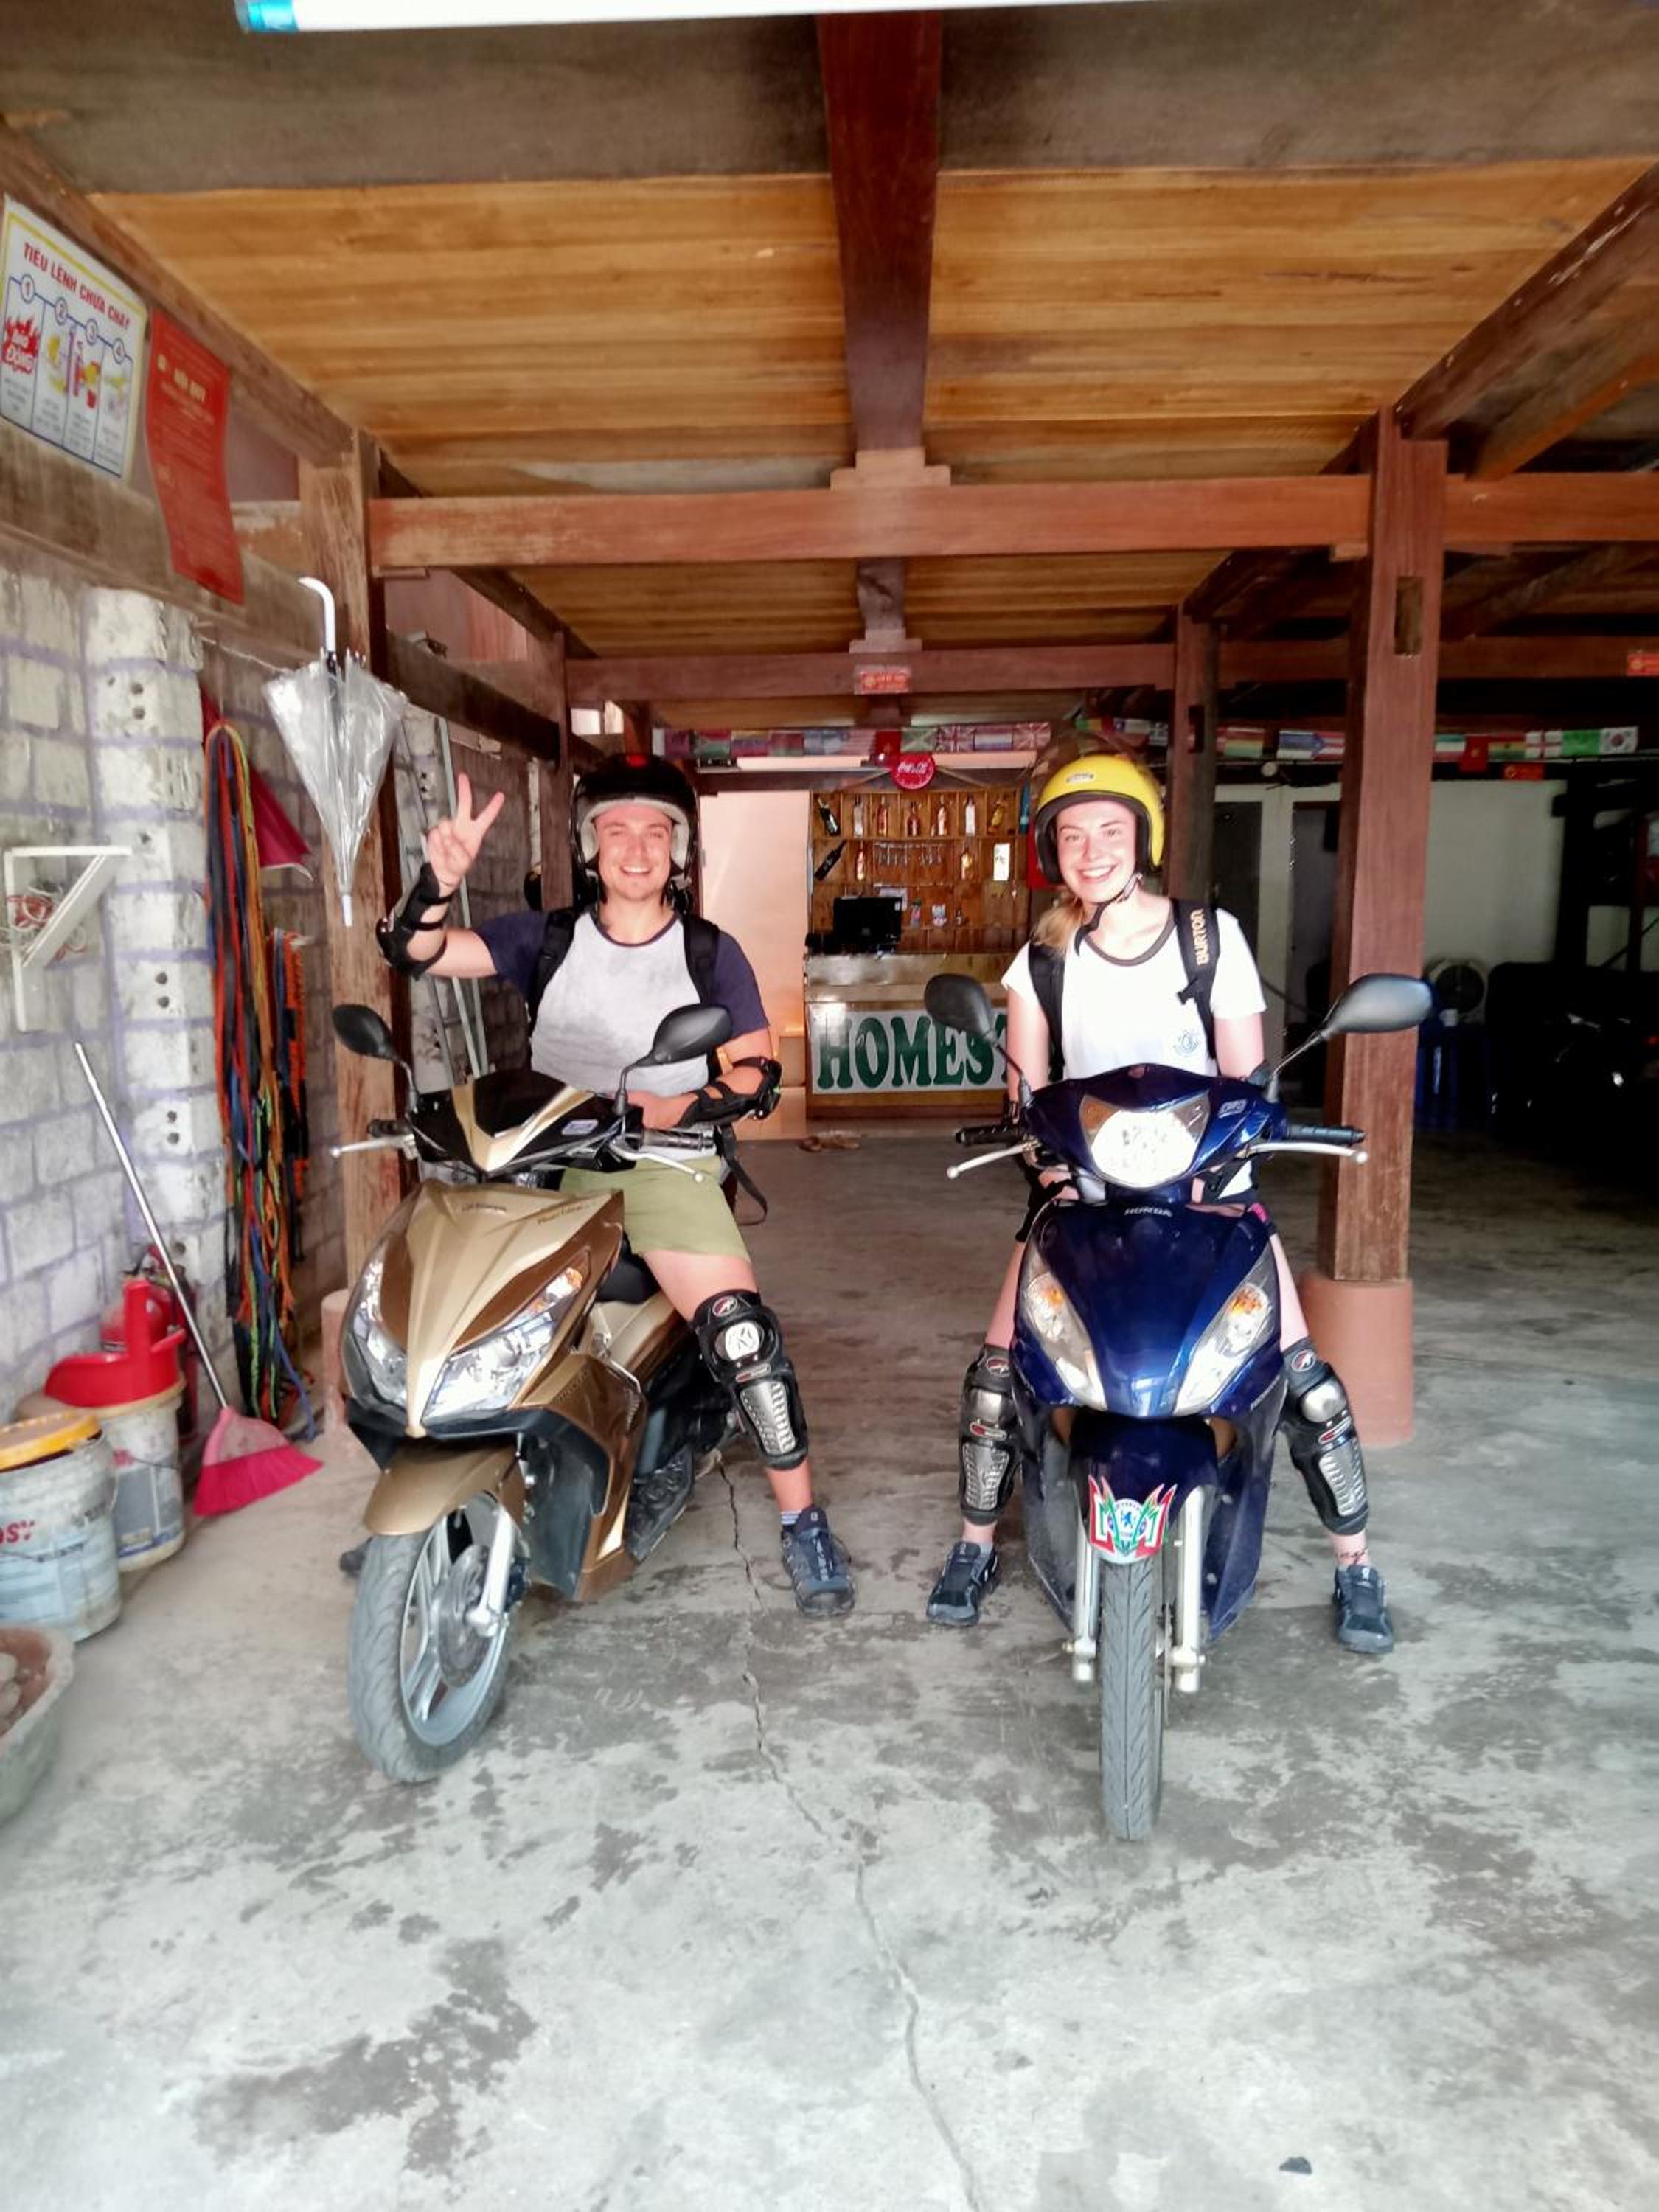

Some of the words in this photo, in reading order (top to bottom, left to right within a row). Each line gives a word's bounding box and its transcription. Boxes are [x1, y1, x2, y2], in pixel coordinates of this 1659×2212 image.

[1189, 908, 1209, 966] BURTON
[818, 1013, 1008, 1089] HOMES
[1124, 1206, 1172, 1217] HONDA
